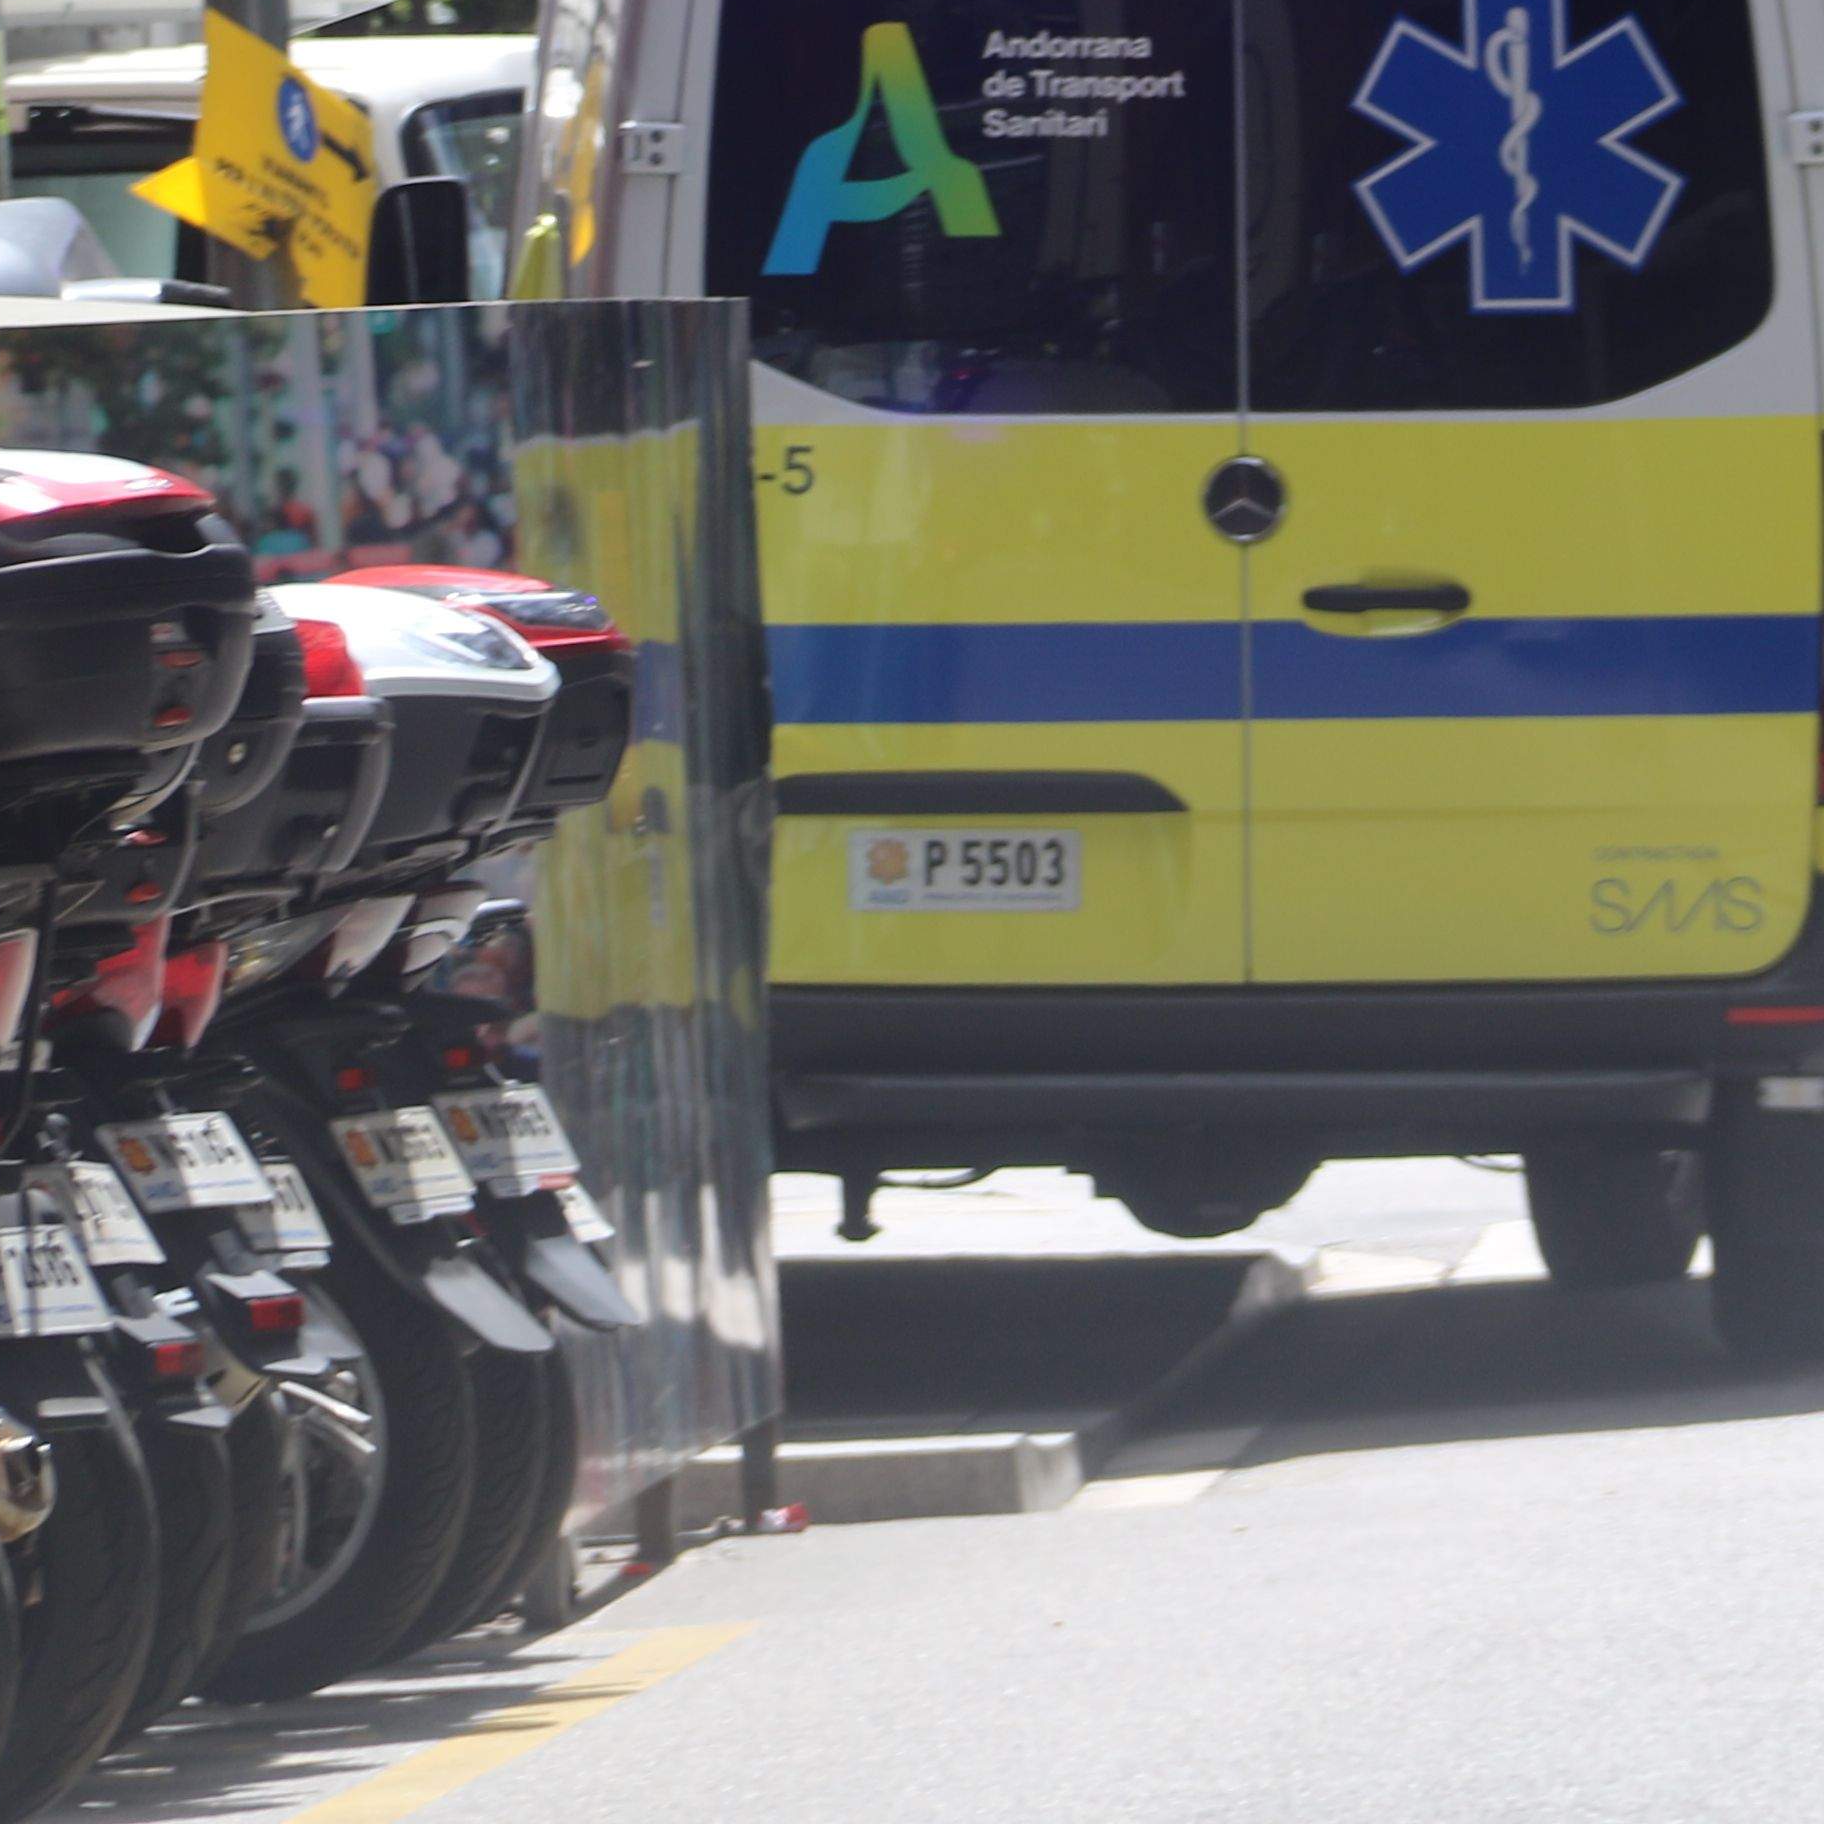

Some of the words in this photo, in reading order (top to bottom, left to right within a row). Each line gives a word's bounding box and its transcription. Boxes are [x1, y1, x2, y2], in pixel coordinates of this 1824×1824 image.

[981, 29, 1152, 59] Andorrana
[981, 69, 1026, 99] de
[1029, 69, 1186, 104] Transport
[981, 107, 1109, 137] Sanitari
